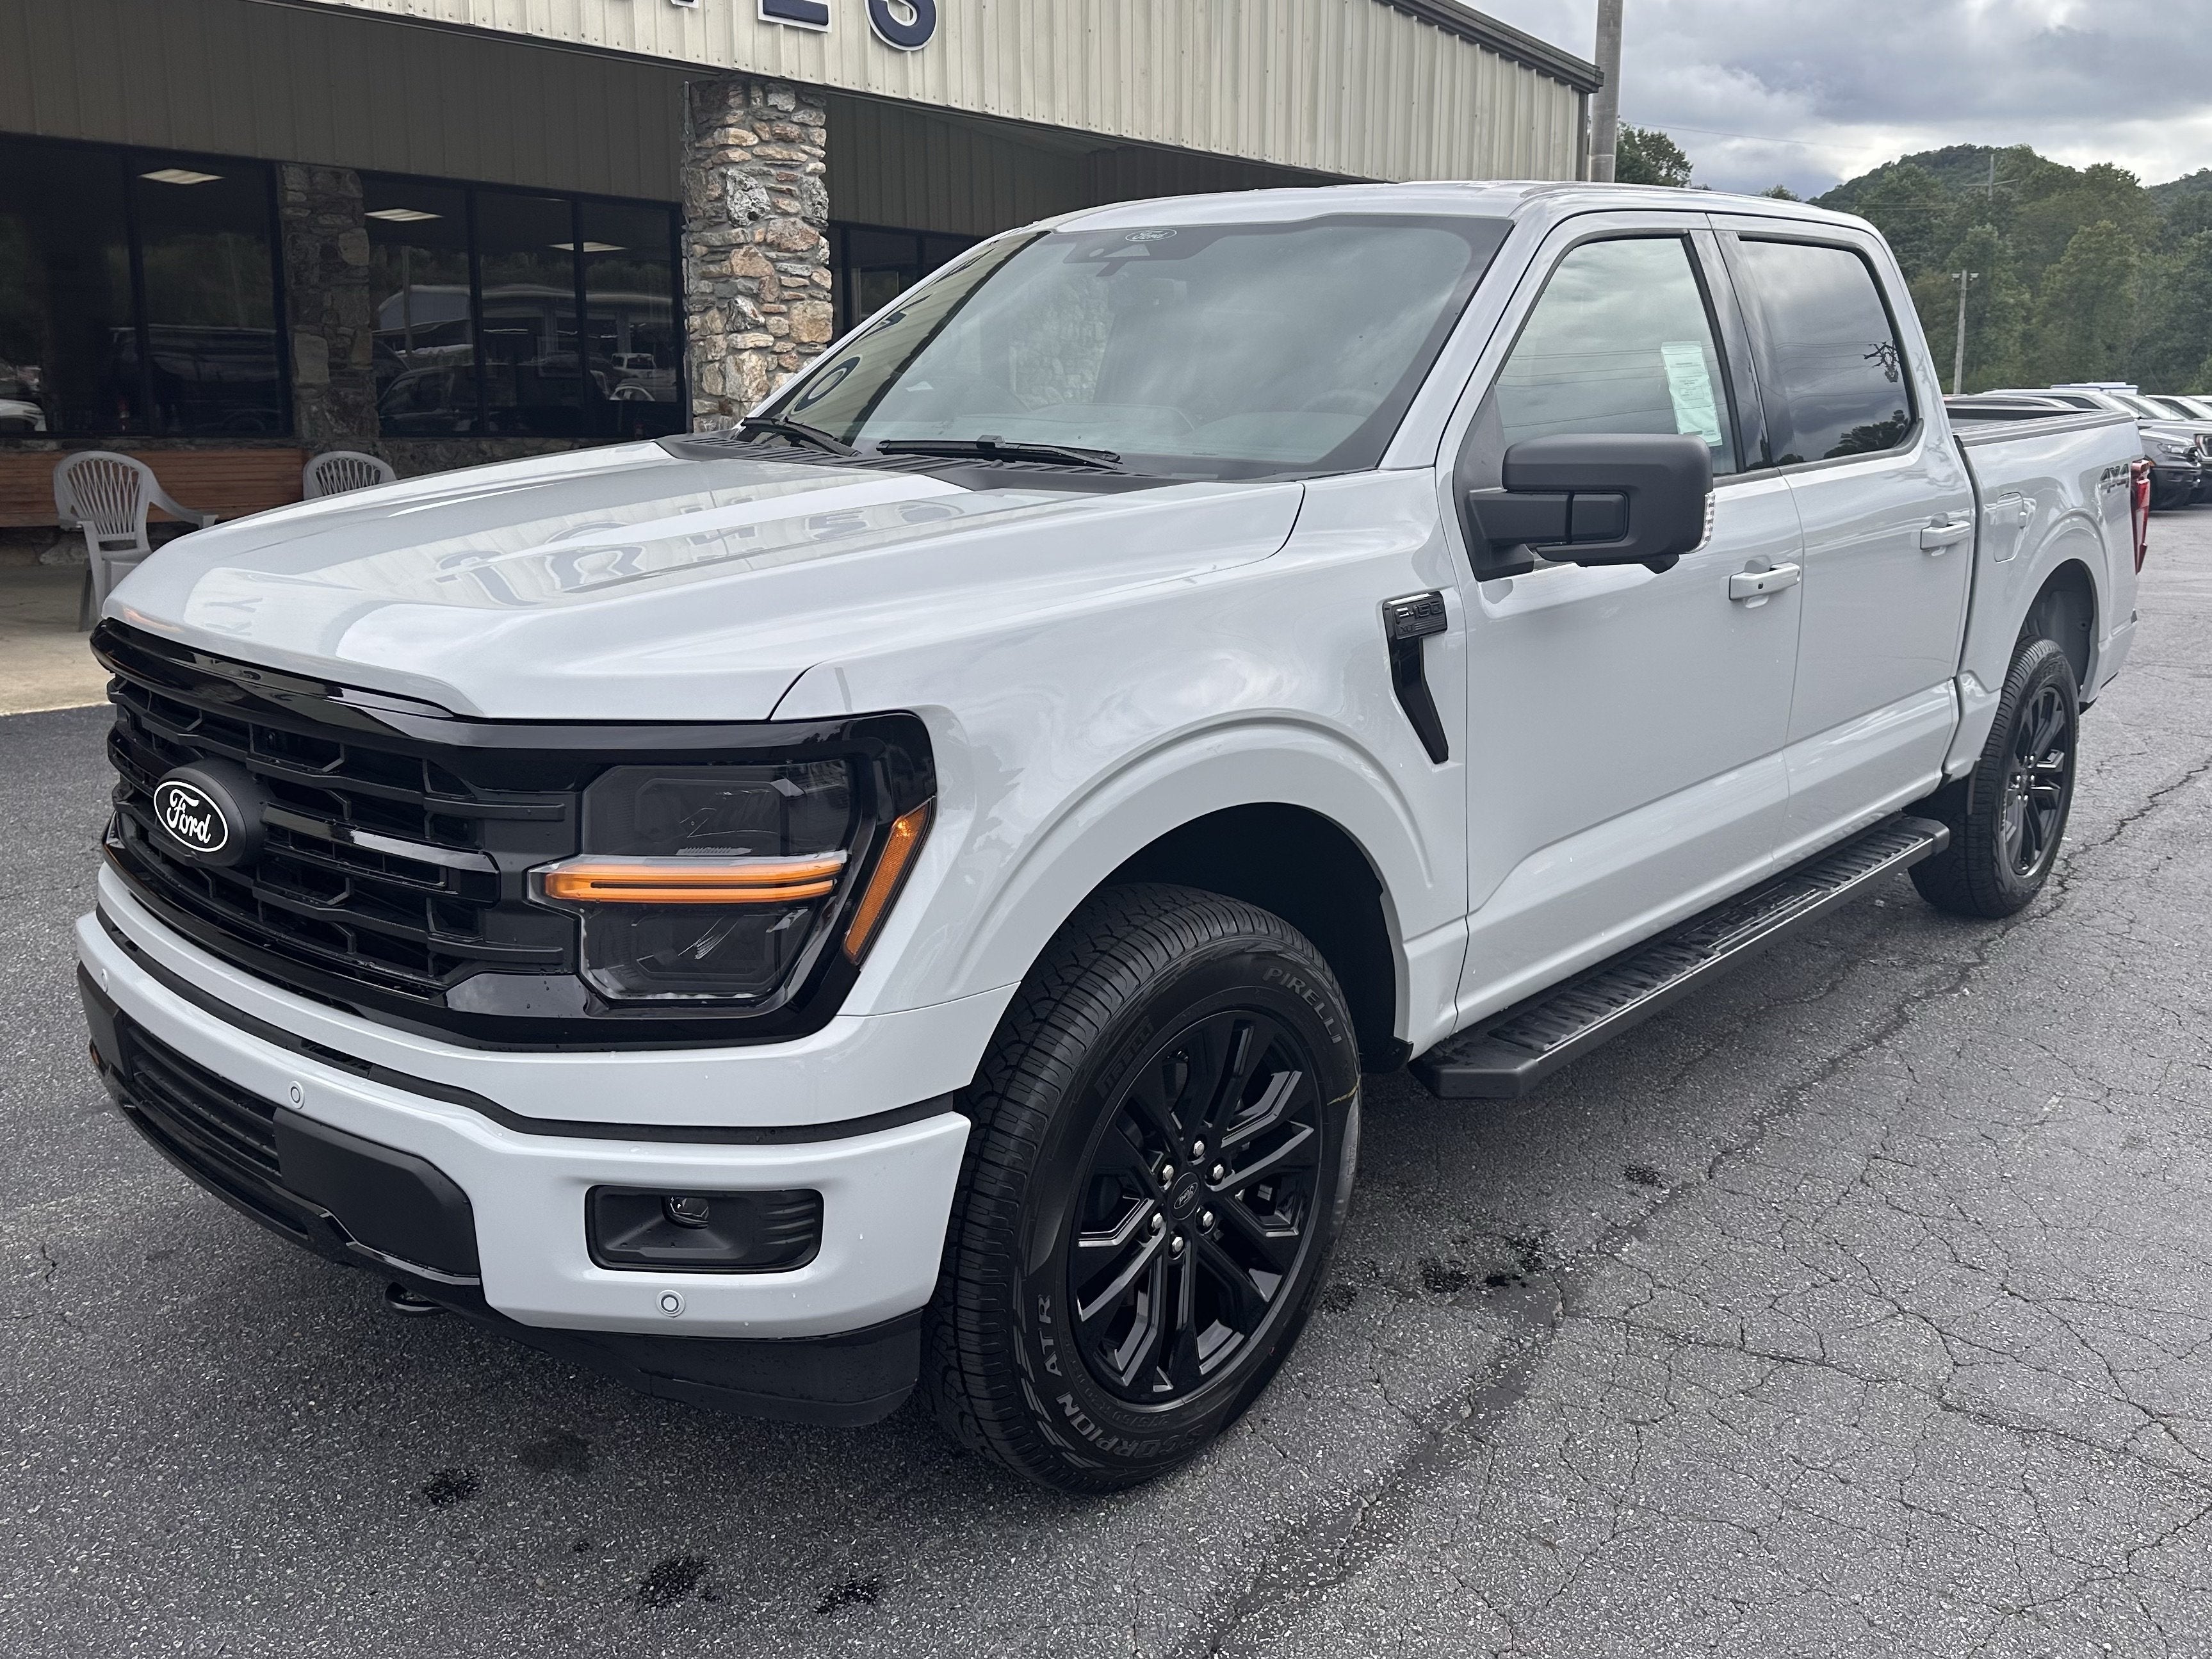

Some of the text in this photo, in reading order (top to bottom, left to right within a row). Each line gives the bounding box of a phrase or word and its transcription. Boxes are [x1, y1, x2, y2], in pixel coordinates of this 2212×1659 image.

[1132, 229, 1169, 240] Ford
[1395, 601, 1443, 625] F-150
[167, 789, 211, 844] Ford
[1262, 965, 1342, 1044] PIRELLI
[1179, 1185, 1194, 1205] Ford
[1037, 1294, 1204, 1459] SCORPION ATR
